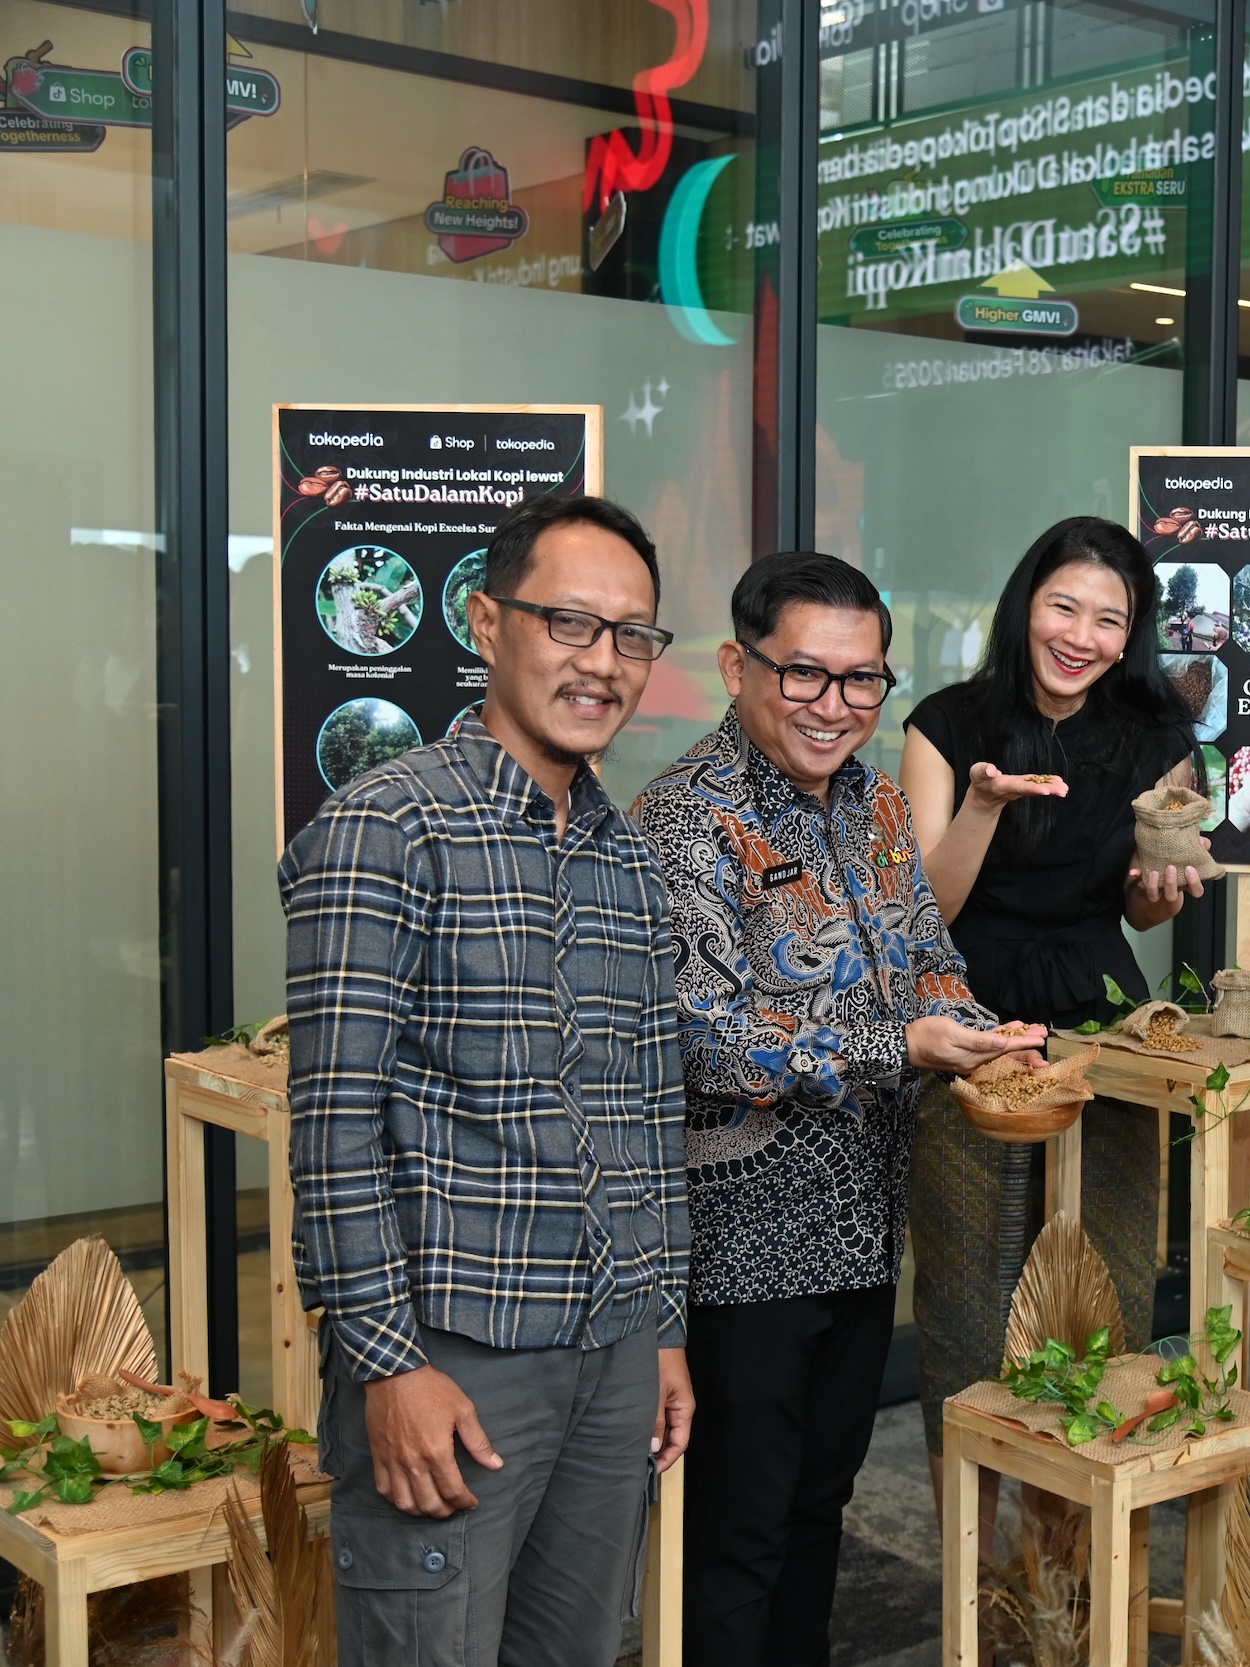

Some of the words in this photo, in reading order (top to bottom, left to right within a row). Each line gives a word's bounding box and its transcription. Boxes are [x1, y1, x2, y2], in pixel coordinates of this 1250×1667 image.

[227, 79, 257, 99] MV!
[70, 88, 115, 109] Shop
[0, 131, 81, 144] ogetherness
[1113, 181, 1155, 196] EKSTRA
[1156, 181, 1186, 196] SERU
[445, 196, 509, 213] Reaching
[434, 212, 463, 226] New
[466, 214, 519, 231] Heights!
[878, 225, 942, 240] Celebrating
[975, 307, 1020, 323] Higher
[1022, 309, 1061, 325] GMV!
[309, 432, 383, 448] tokopedia
[445, 436, 475, 451] Shop
[496, 438, 554, 452] tokopedia
[346, 467, 399, 483] Dukung
[402, 468, 454, 481] Industri
[456, 469, 491, 482] Lokal
[493, 469, 524, 485] Kopi
[526, 470, 564, 483] lewat
[1165, 476, 1233, 492] tokopedia
[354, 483, 524, 508] #SatuDalamKopi
[1198, 508, 1246, 522] Dukung
[334, 521, 363, 532] Fakta
[364, 522, 413, 534] Mengenai
[414, 523, 438, 535] Kopi
[439, 523, 477, 533] Excelsa
[328, 664, 368, 672] Merupakan
[368, 665, 412, 674] peninggalan
[365, 671, 394, 679] kolonial
